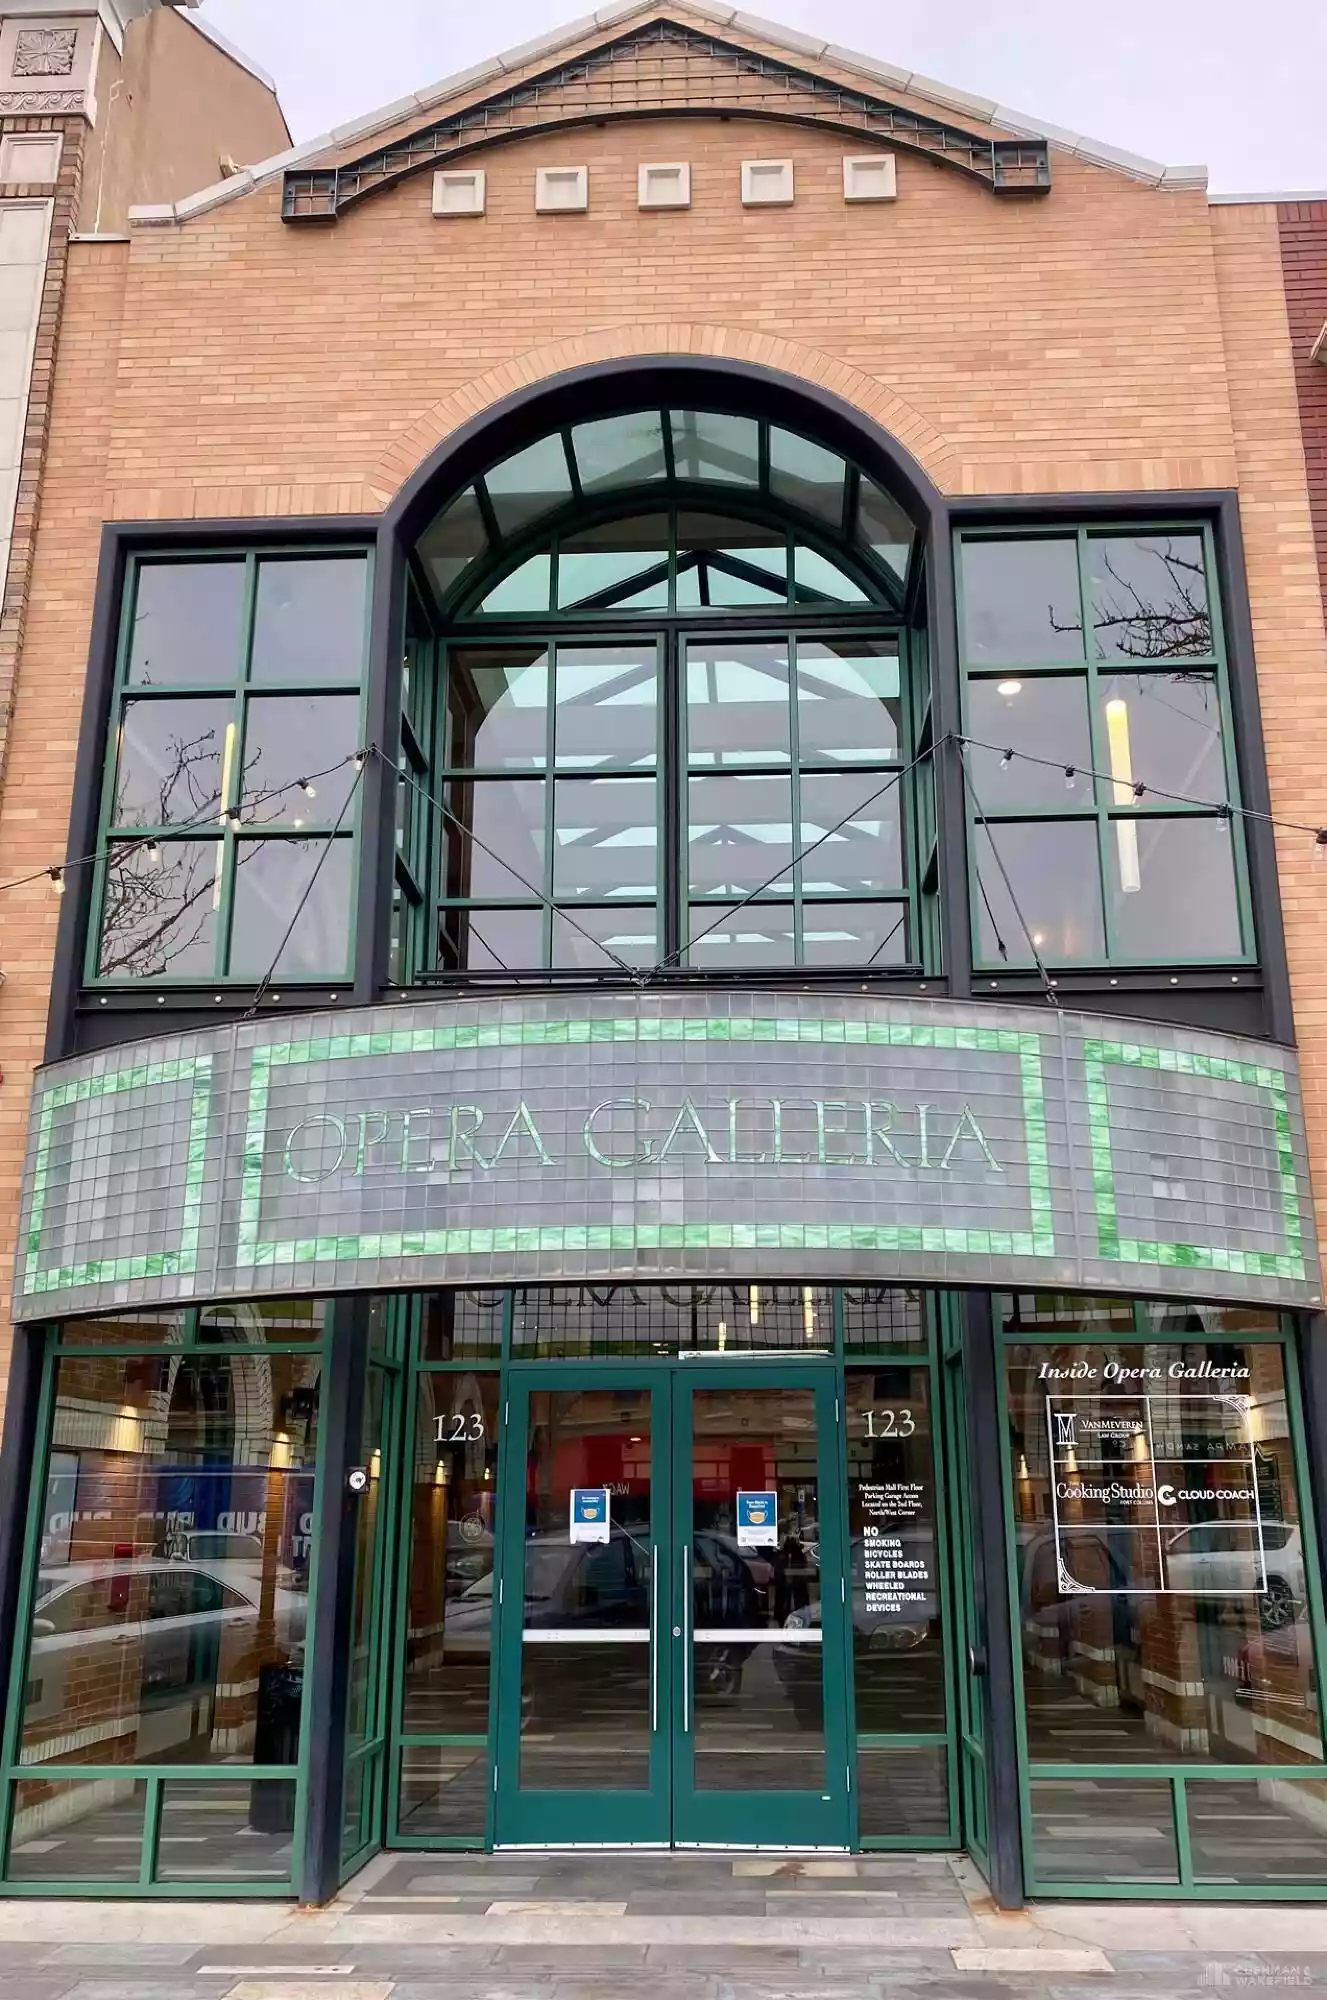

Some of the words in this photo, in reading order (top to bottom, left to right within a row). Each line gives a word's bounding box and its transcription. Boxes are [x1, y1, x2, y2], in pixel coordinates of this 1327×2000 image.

[284, 1098, 556, 1183] OPERA
[583, 1095, 1005, 1174] GALLERIA
[1038, 1361, 1097, 1379] Inside
[1103, 1361, 1163, 1385] Opera
[1168, 1360, 1251, 1379] Galleria
[432, 1413, 485, 1442] 123
[862, 1408, 916, 1439] 123
[1057, 1482, 1111, 1504] Cooking
[1111, 1482, 1154, 1499] Studio
[1178, 1489, 1215, 1500] CLOUD
[1216, 1489, 1255, 1501] COACH
[863, 1526, 879, 1537] NO
[864, 1539, 902, 1547] SMOKING
[864, 1550, 903, 1558] BICYCLES
[865, 1571, 896, 1579] ROLLER
[897, 1571, 929, 1579] BLADES
[865, 1582, 905, 1590] WHEELED
[865, 1592, 927, 1601] RECREATIONAL
[866, 1603, 901, 1612] DEVICES
